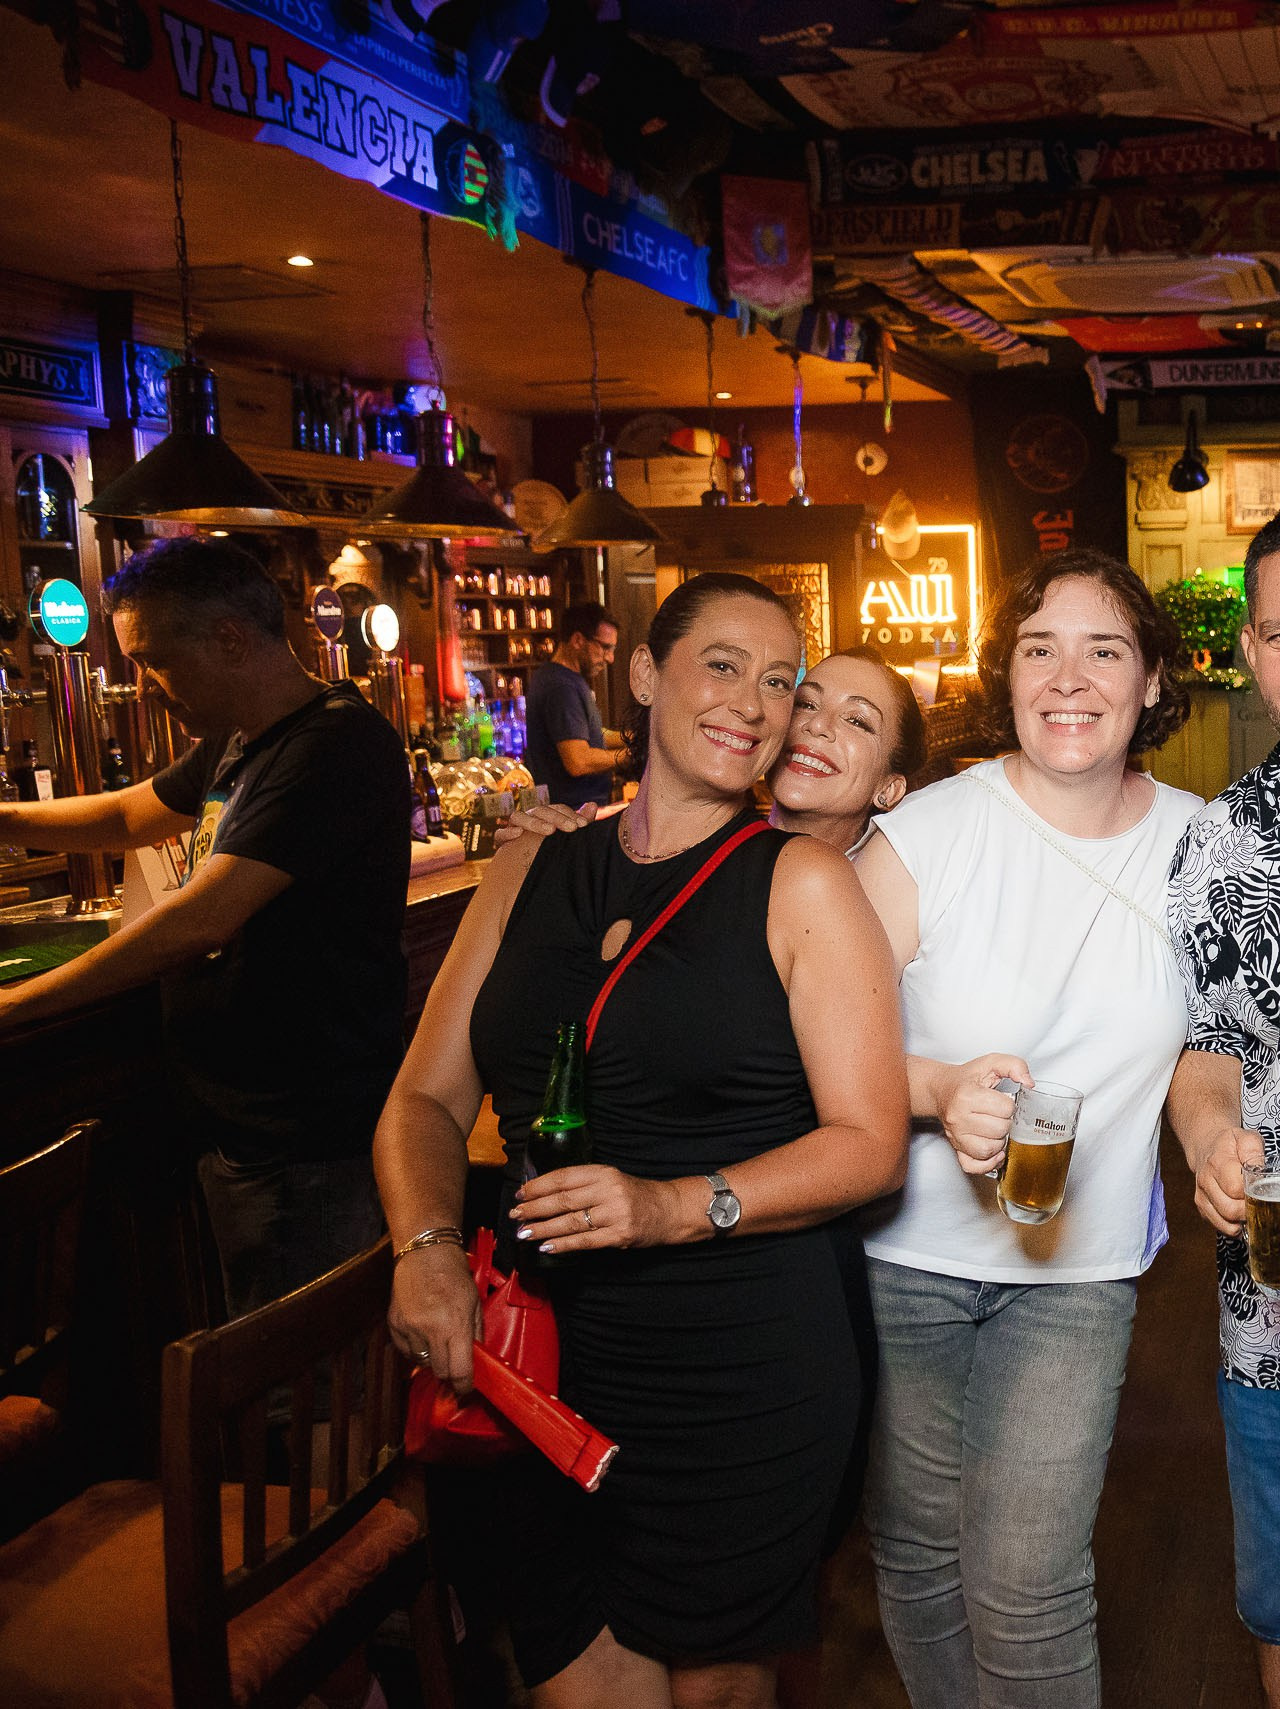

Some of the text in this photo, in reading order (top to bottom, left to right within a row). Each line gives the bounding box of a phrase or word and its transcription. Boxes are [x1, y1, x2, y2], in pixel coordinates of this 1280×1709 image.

[161, 10, 439, 191] VALENCIA
[911, 148, 1049, 189] CHELSEA
[928, 557, 948, 573] 79
[861, 627, 957, 644] VODKA
[1035, 1118, 1066, 1131] Mahou
